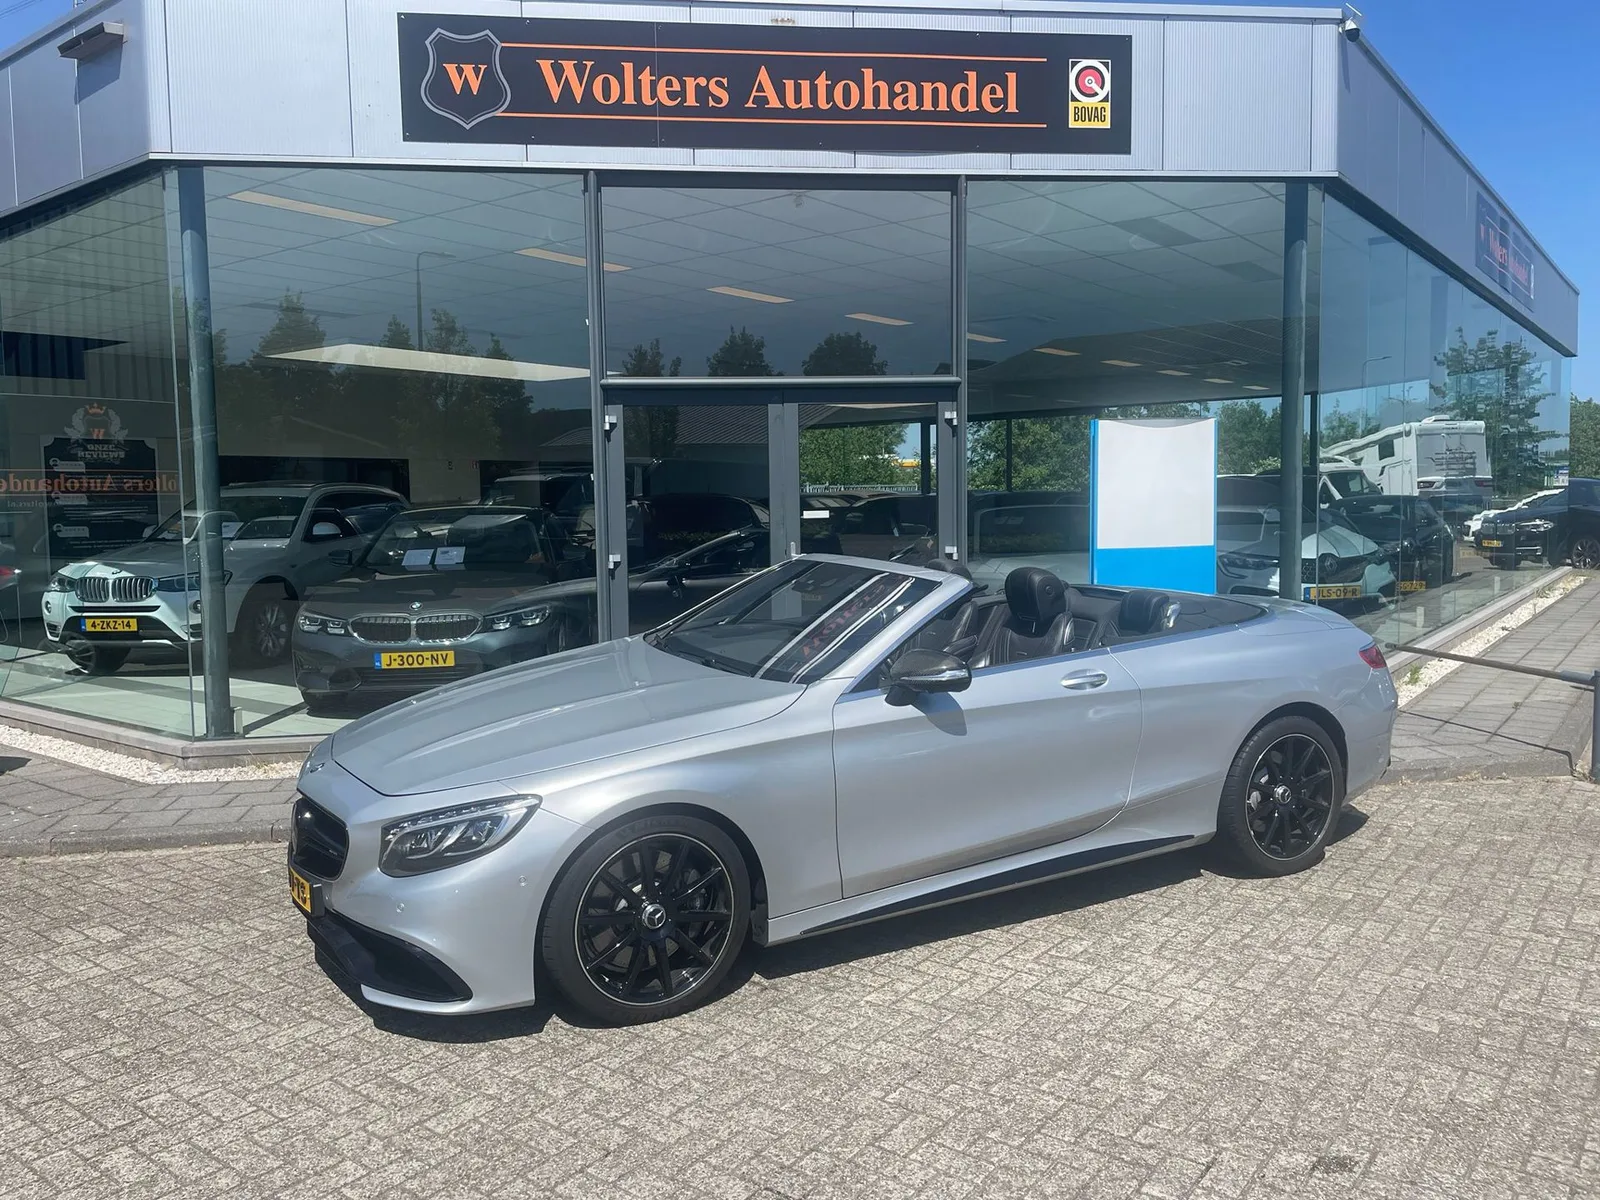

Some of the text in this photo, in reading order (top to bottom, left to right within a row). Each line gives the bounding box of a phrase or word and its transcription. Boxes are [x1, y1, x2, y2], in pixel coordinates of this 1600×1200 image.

[442, 63, 488, 95] W
[535, 59, 1019, 113] Wolters Autohandel
[1073, 106, 1106, 123] BOVAG
[77, 450, 125, 458] REVIEWS
[90, 619, 132, 631] 4-ZKZ-14
[386, 653, 449, 667] J-300-NV
